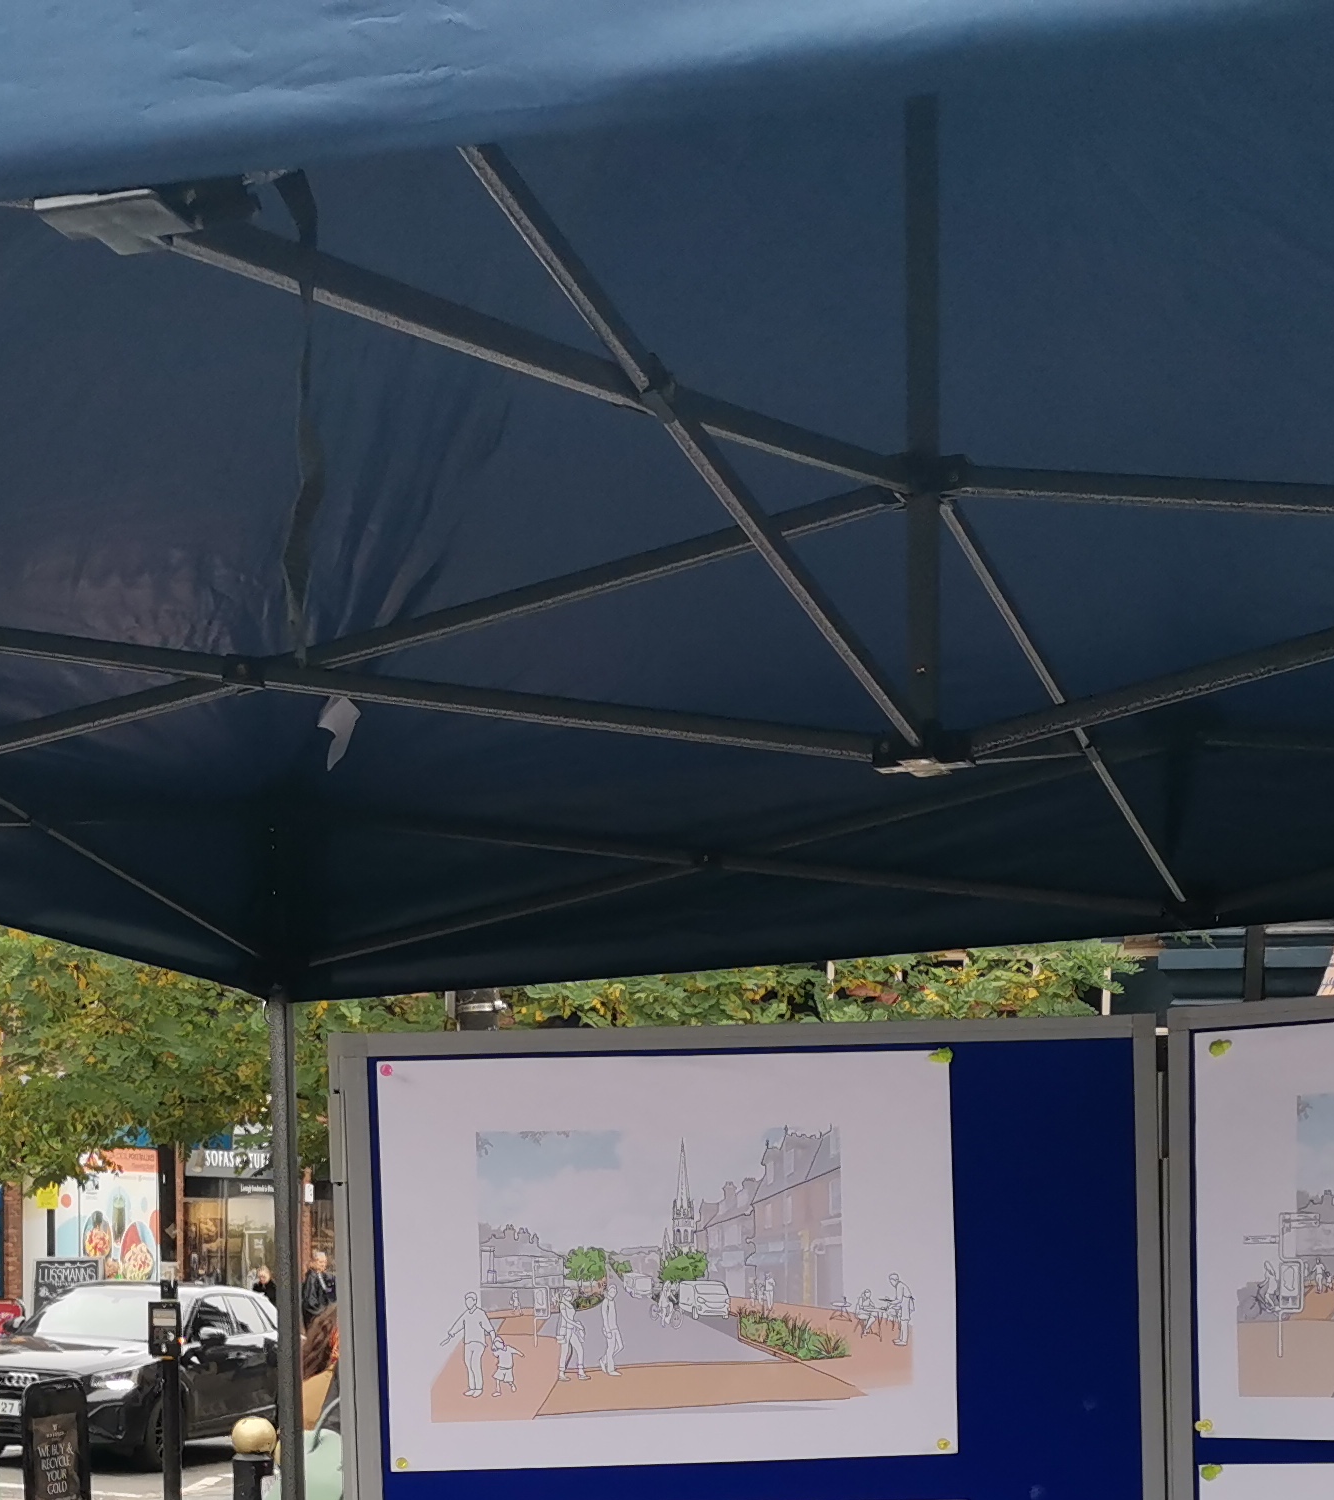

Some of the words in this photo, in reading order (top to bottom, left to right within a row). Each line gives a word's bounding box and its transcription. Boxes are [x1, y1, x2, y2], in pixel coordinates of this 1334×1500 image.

[205, 1150, 234, 1168] SOFAS
[41, 1458, 72, 1472] RECYCLE
[46, 1470, 67, 1483] YOUR
[47, 1482, 67, 1495] GOLD
